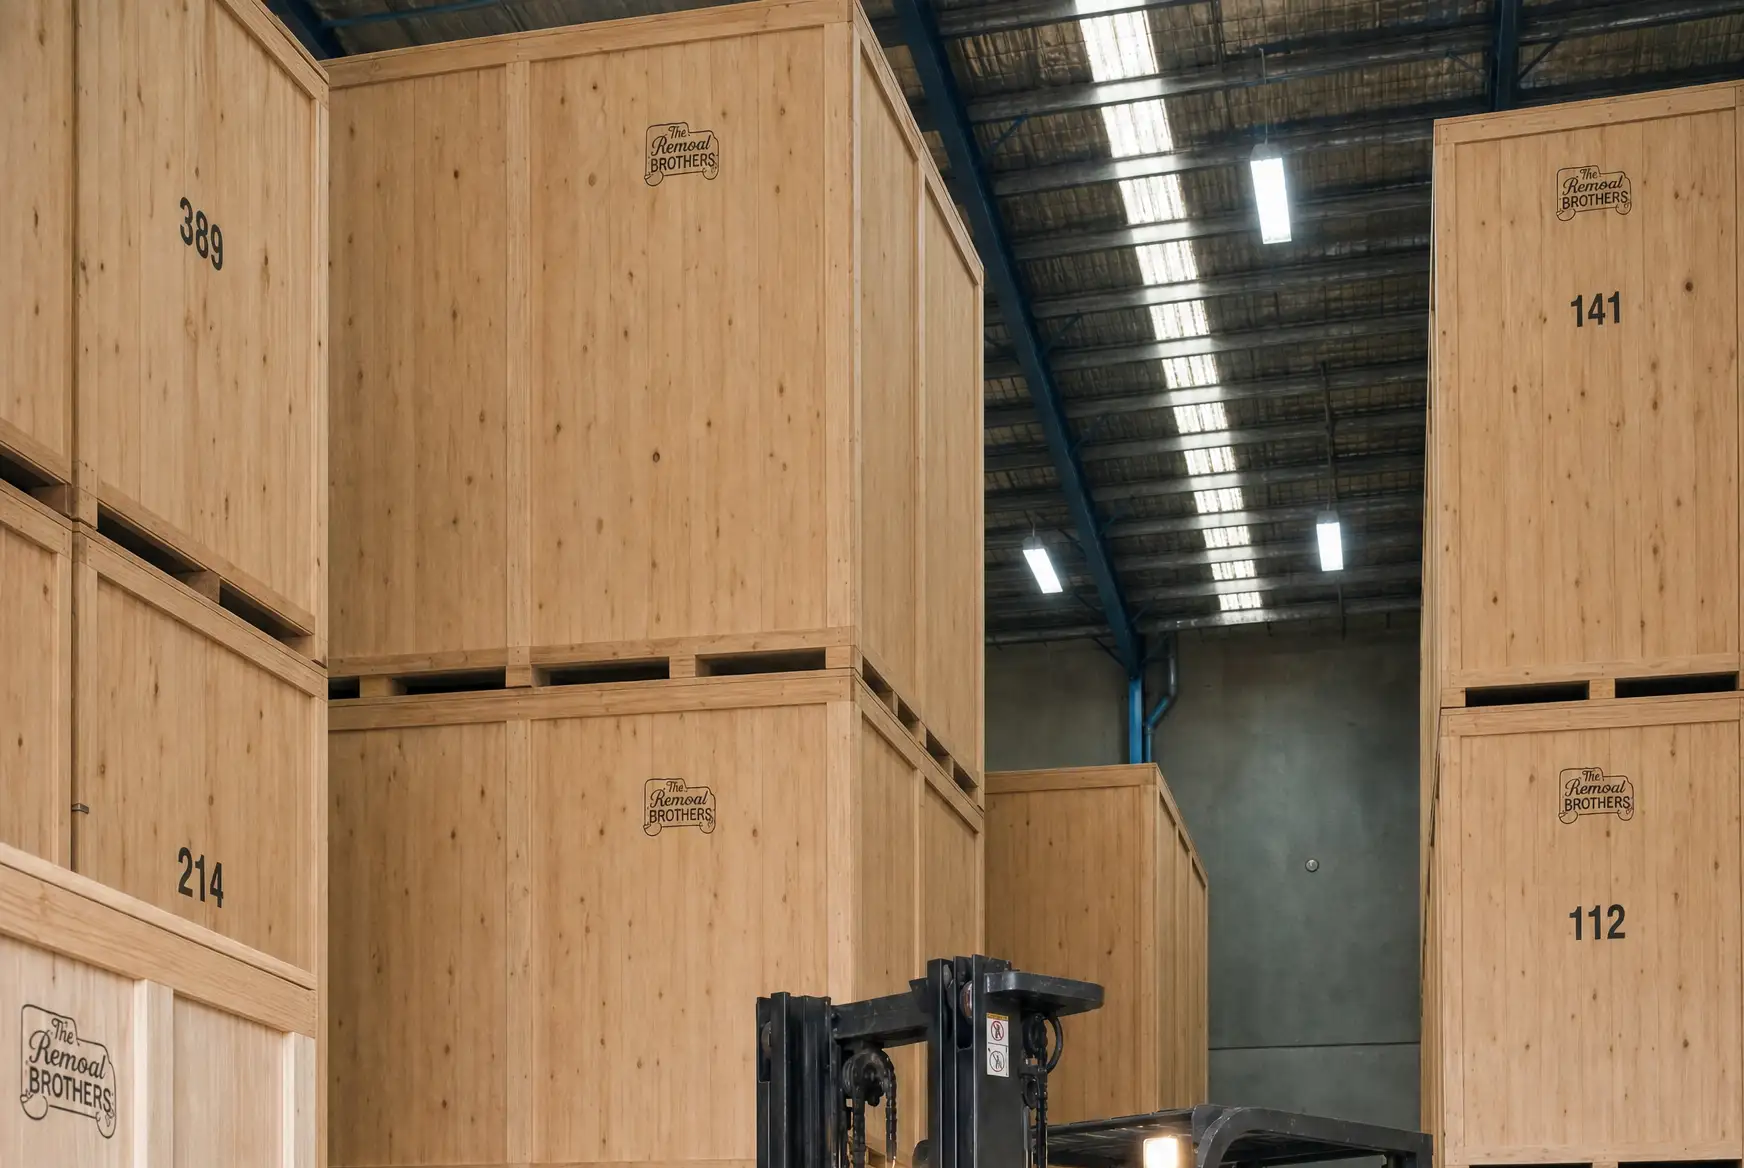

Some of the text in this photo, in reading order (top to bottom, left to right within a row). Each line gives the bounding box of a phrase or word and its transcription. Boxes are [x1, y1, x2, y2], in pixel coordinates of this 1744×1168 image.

[668, 126, 687, 139] The
[651, 134, 711, 156] Remoal
[651, 152, 715, 173] BROTHERS
[1580, 168, 1597, 180] The
[1562, 175, 1623, 195] Remoal
[1562, 191, 1628, 209] BROTHERS
[180, 197, 223, 271] 389
[1571, 291, 1619, 327] 141
[1582, 770, 1600, 781] The
[666, 781, 684, 792] The
[1565, 778, 1625, 796] Remoal
[650, 789, 708, 808] Remoal
[1565, 796, 1630, 811] BROTHERS
[650, 808, 712, 823] BROTHERS
[178, 847, 223, 908] 214
[1569, 904, 1625, 940] 112
[52, 1018, 73, 1044] The
[29, 1030, 106, 1079] Remoal
[30, 1066, 111, 1113] BROTHERS
